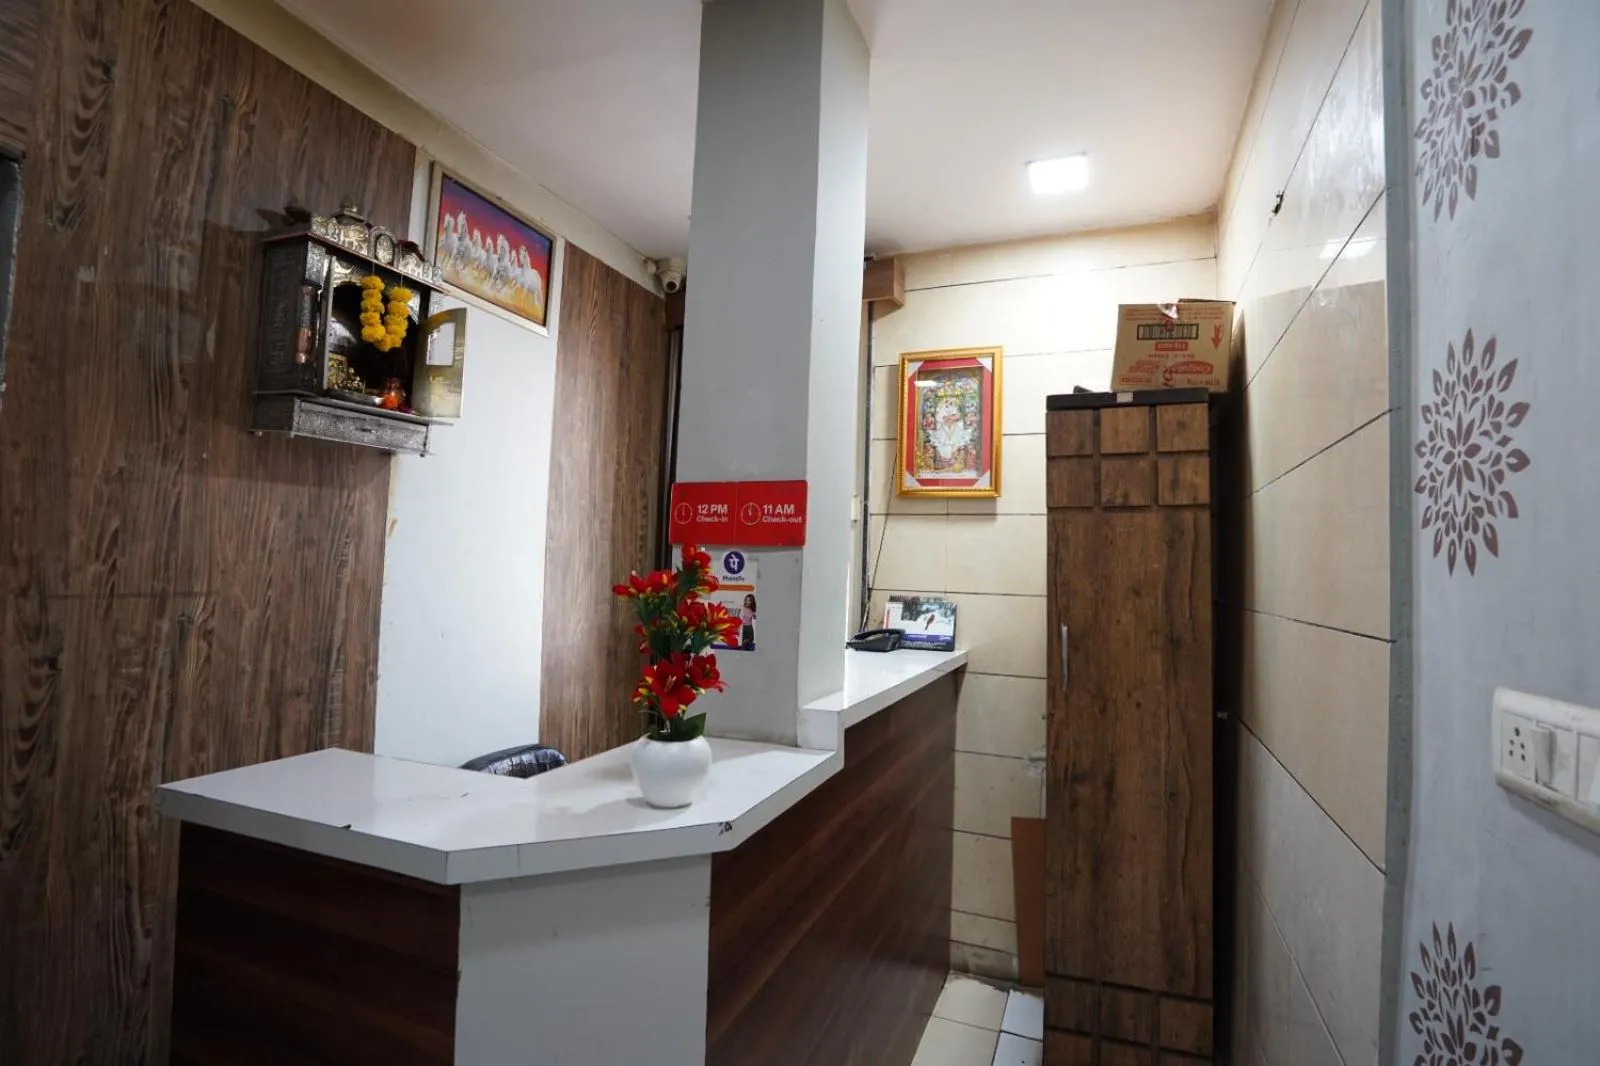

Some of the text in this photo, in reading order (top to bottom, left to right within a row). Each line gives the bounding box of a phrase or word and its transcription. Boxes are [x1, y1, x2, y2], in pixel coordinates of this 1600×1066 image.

[697, 504, 728, 514] 12 PM
[763, 504, 795, 514] 11 AM
[696, 515, 728, 523] Check-in
[762, 515, 802, 523] Check-out
